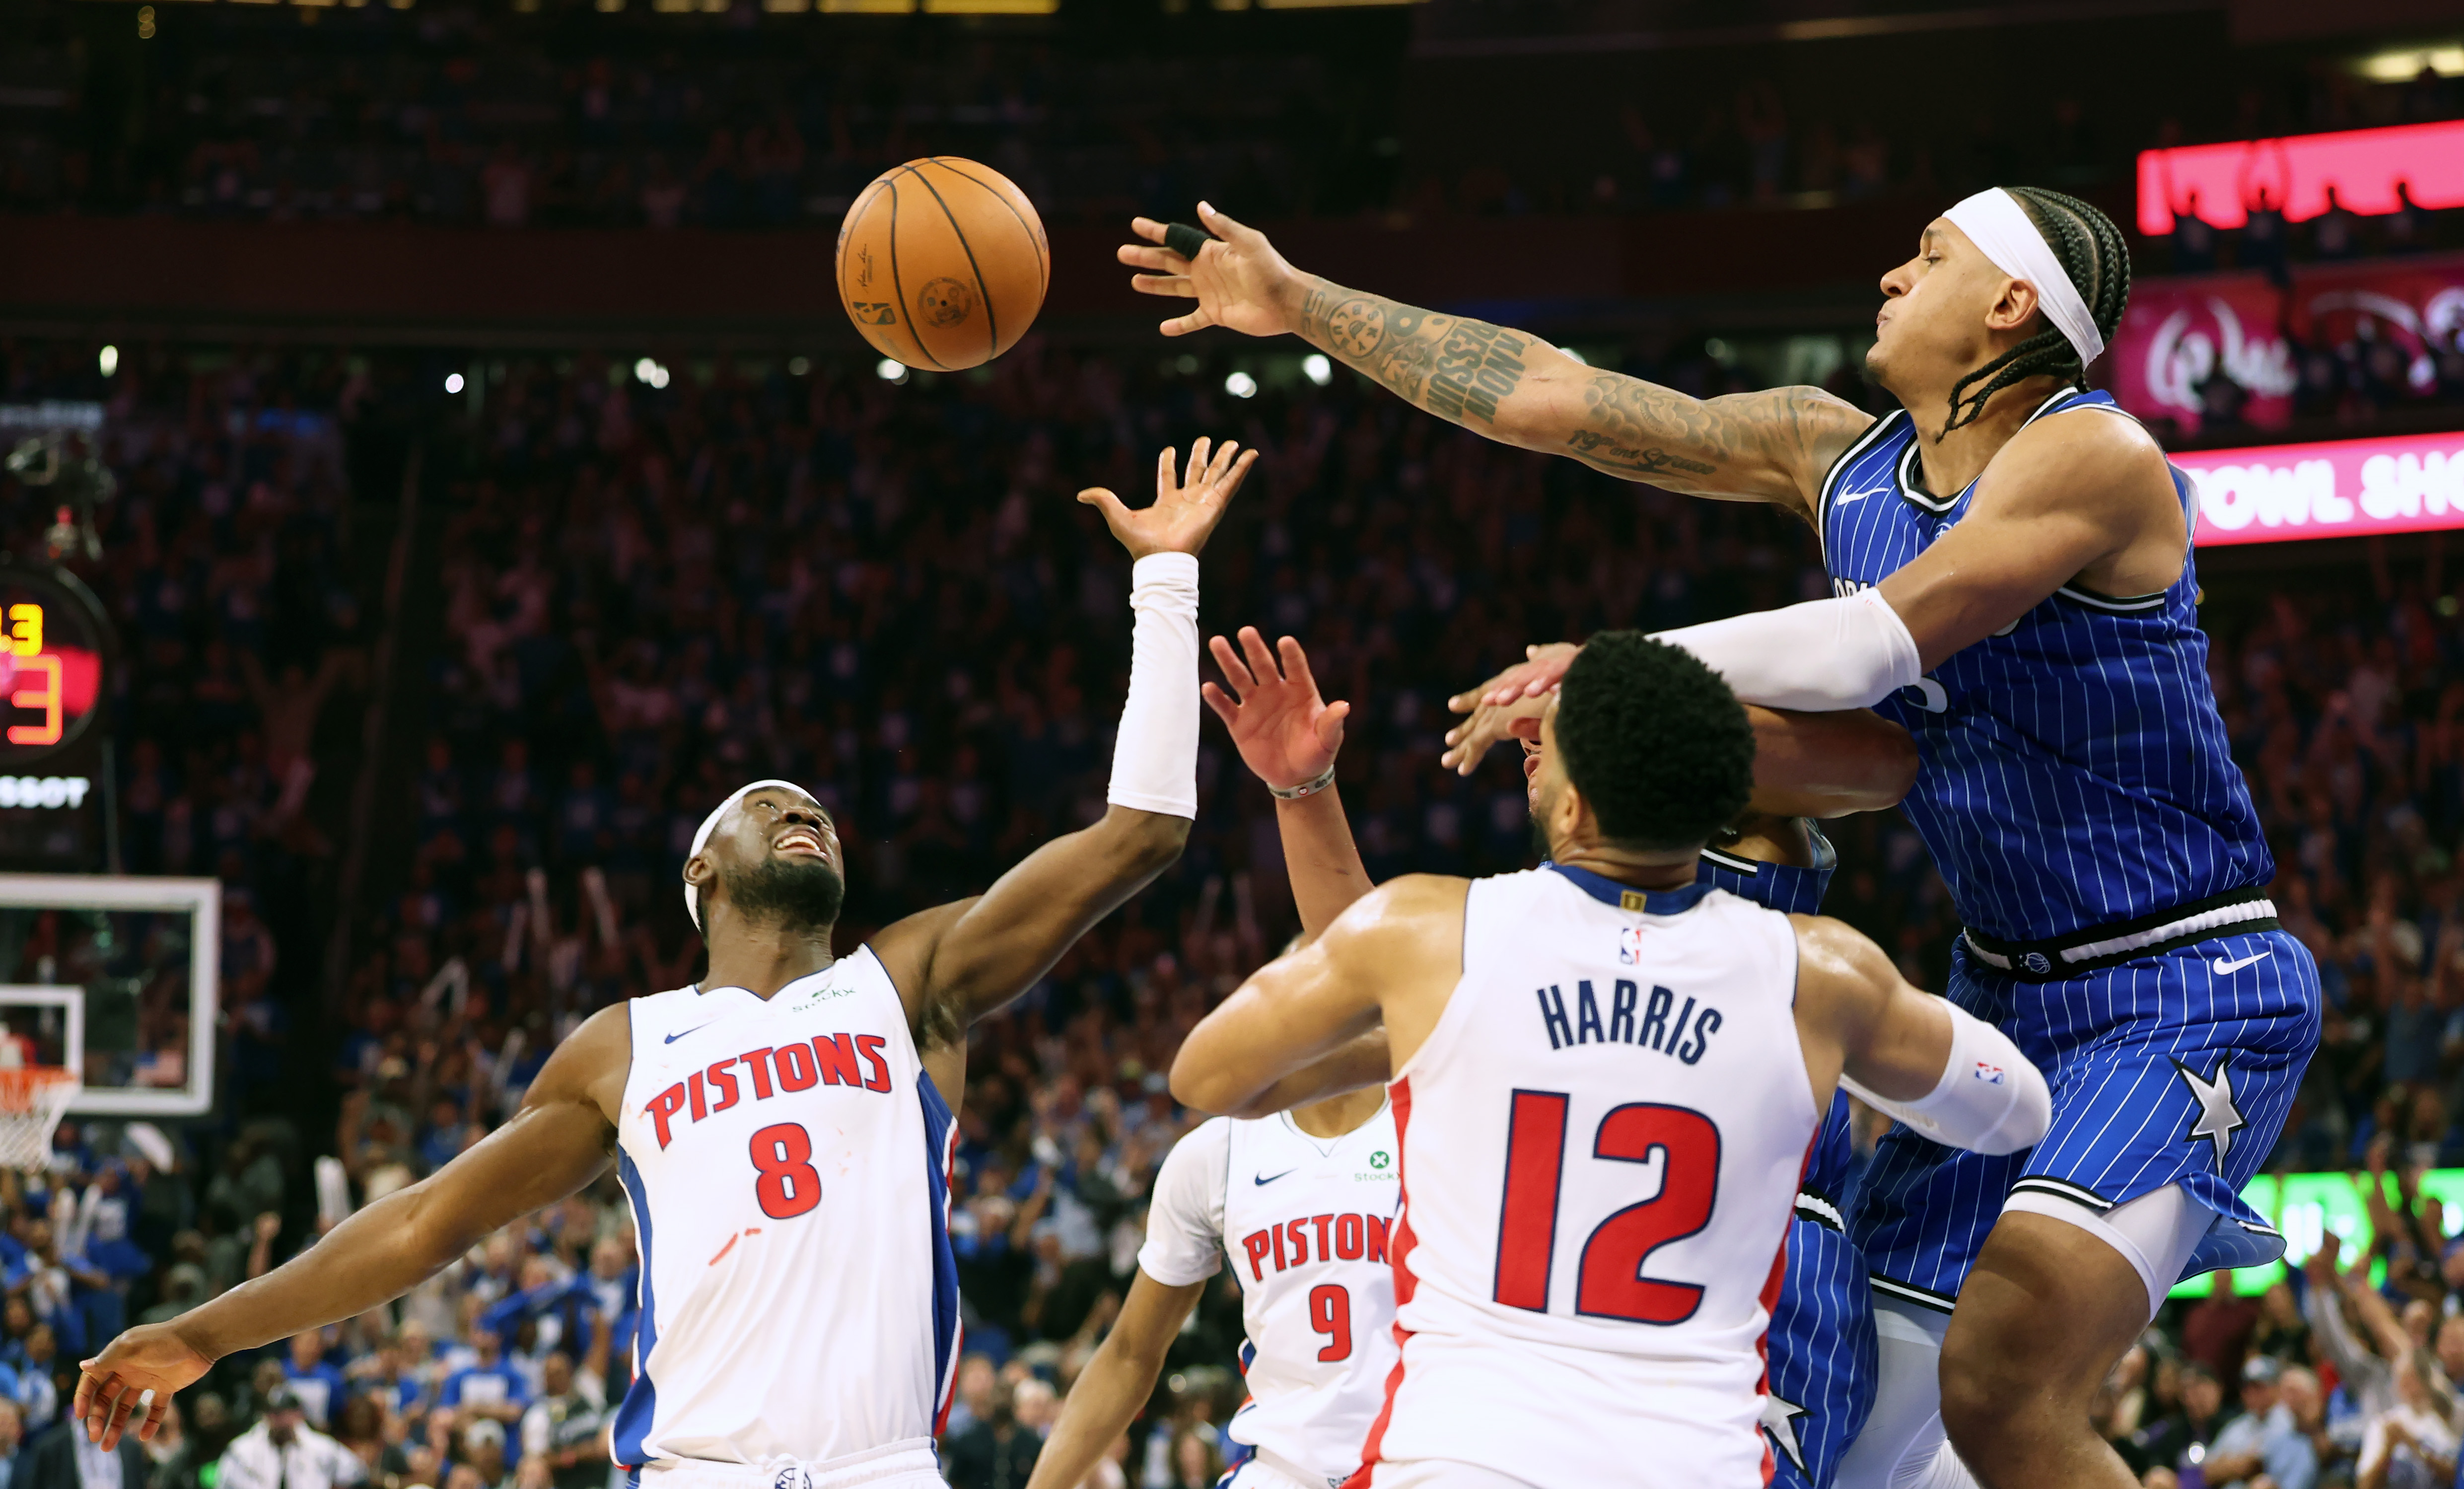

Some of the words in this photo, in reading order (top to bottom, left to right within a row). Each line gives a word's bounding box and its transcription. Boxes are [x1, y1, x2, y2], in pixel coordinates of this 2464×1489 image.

[1426, 321, 1498, 422] RESSUR
[1465, 332, 1526, 425] KNOW
[1537, 979, 1721, 1065] HARRIS
[646, 1033, 893, 1151] PISTONS
[750, 1122, 821, 1219] 8
[1492, 1088, 1721, 1326] 12
[1310, 1284, 1352, 1362] 9
